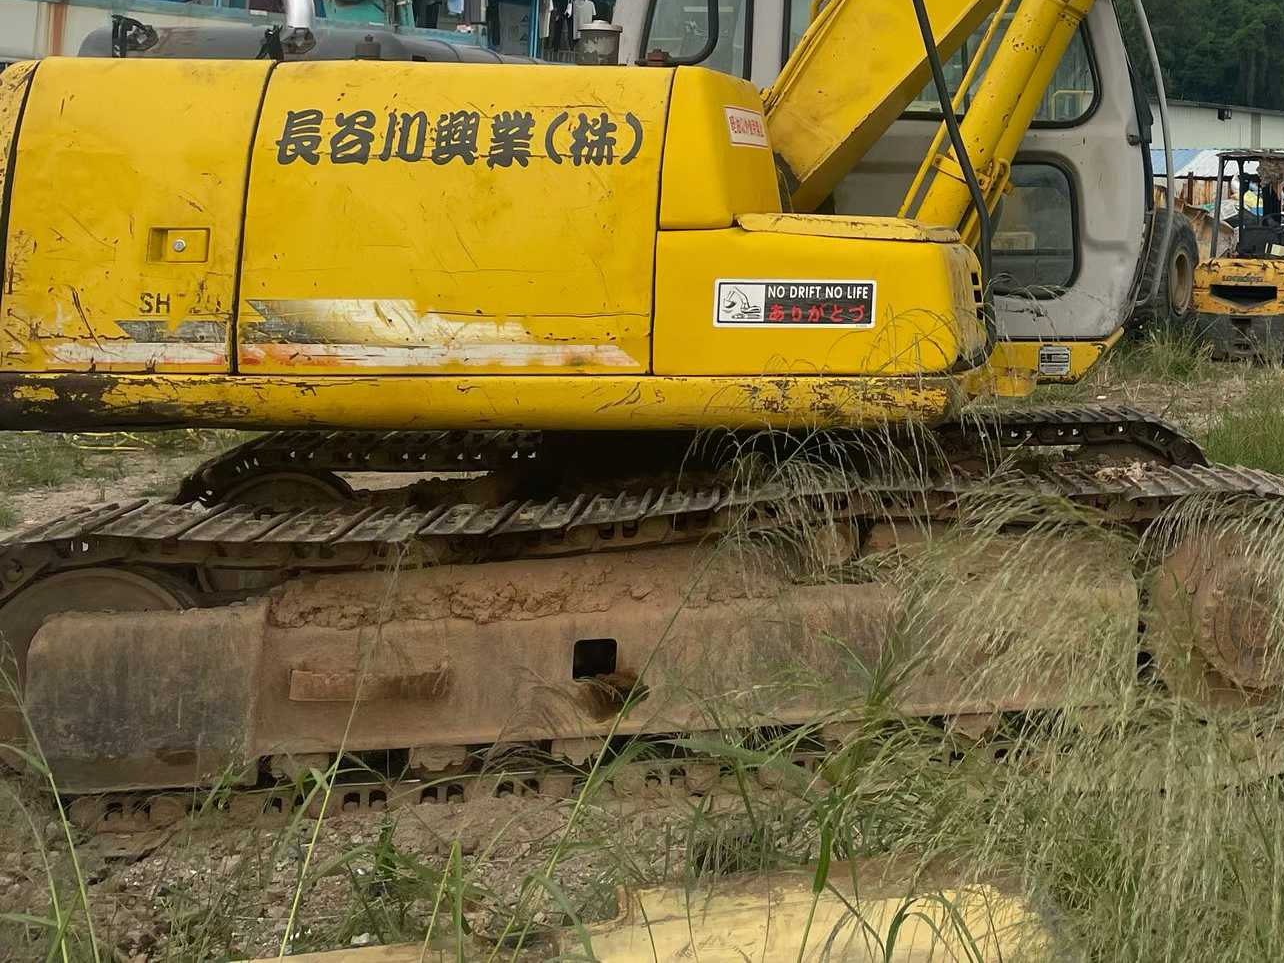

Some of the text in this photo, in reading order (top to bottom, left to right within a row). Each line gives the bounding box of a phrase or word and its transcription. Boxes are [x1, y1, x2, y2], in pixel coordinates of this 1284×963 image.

[767, 286, 869, 299] NO DRIFT NO LIFE
